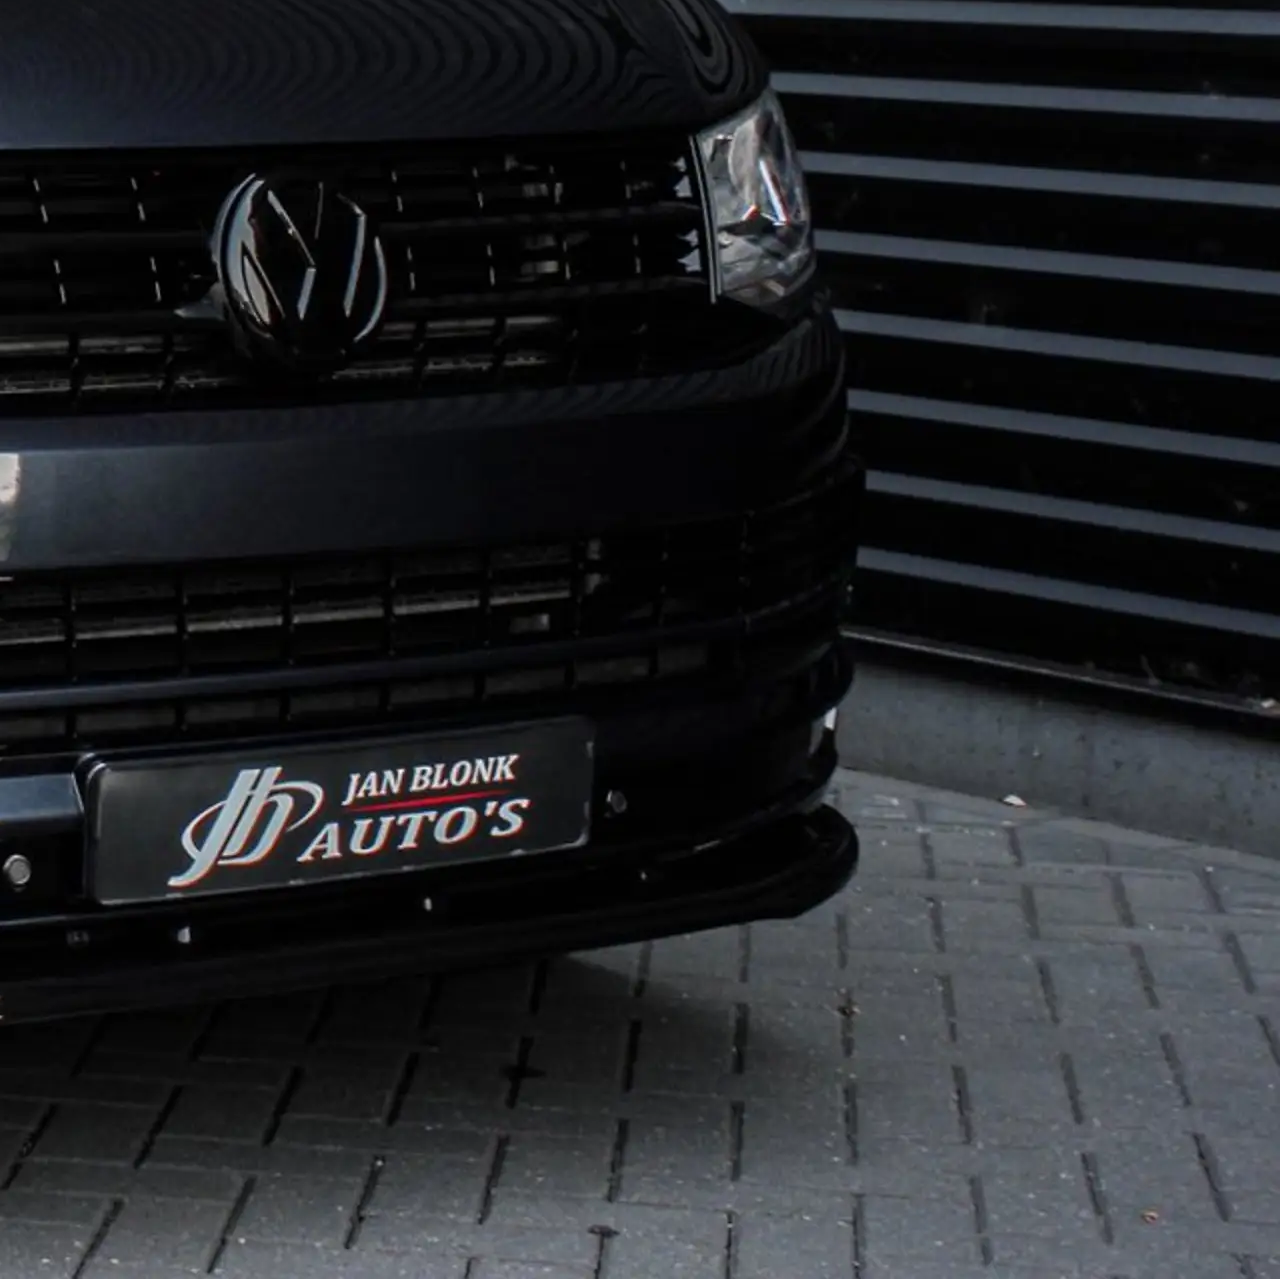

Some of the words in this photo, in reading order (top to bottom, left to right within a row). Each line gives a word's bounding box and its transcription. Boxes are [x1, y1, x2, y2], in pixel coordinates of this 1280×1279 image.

[342, 768, 406, 806] JAN
[408, 754, 520, 793] BLONK
[296, 798, 532, 863] AUTO'S
